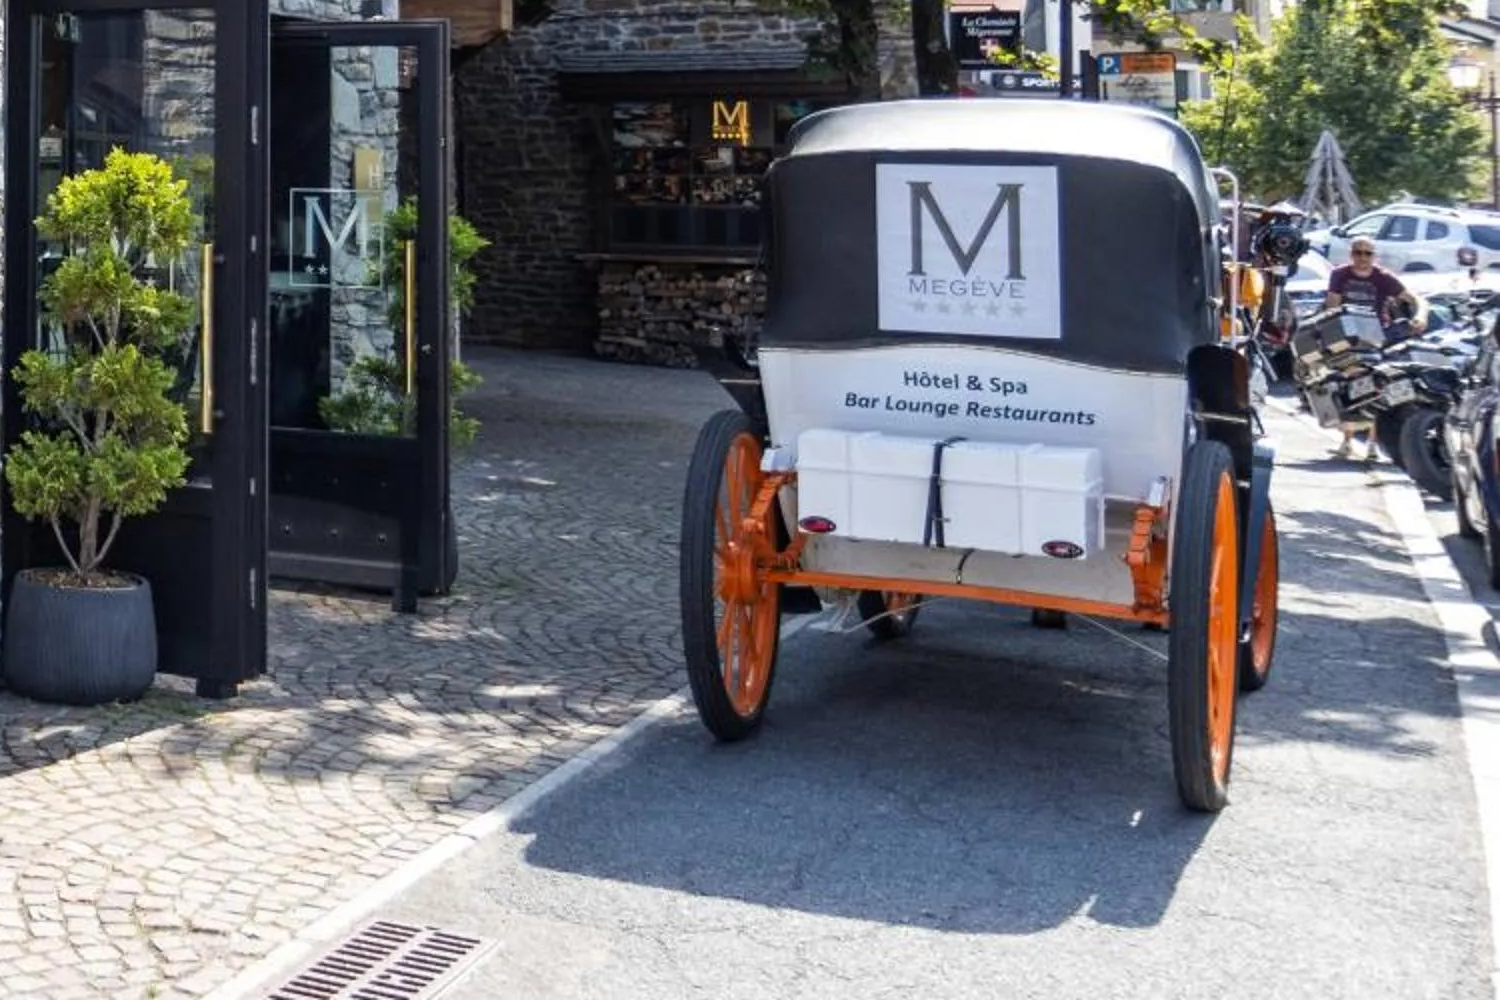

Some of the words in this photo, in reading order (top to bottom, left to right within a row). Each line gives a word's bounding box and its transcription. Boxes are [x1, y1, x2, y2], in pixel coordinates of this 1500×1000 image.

[713, 101, 747, 128] M
[302, 196, 371, 260] M
[904, 181, 1027, 281] M
[908, 275, 1027, 299] MEGÈVE
[902, 370, 960, 391] Hôtel
[966, 375, 983, 391] &
[989, 376, 1029, 396] Spa
[843, 391, 881, 409] Bar
[884, 394, 960, 418] Lounge
[965, 401, 1097, 426] Restaurants
